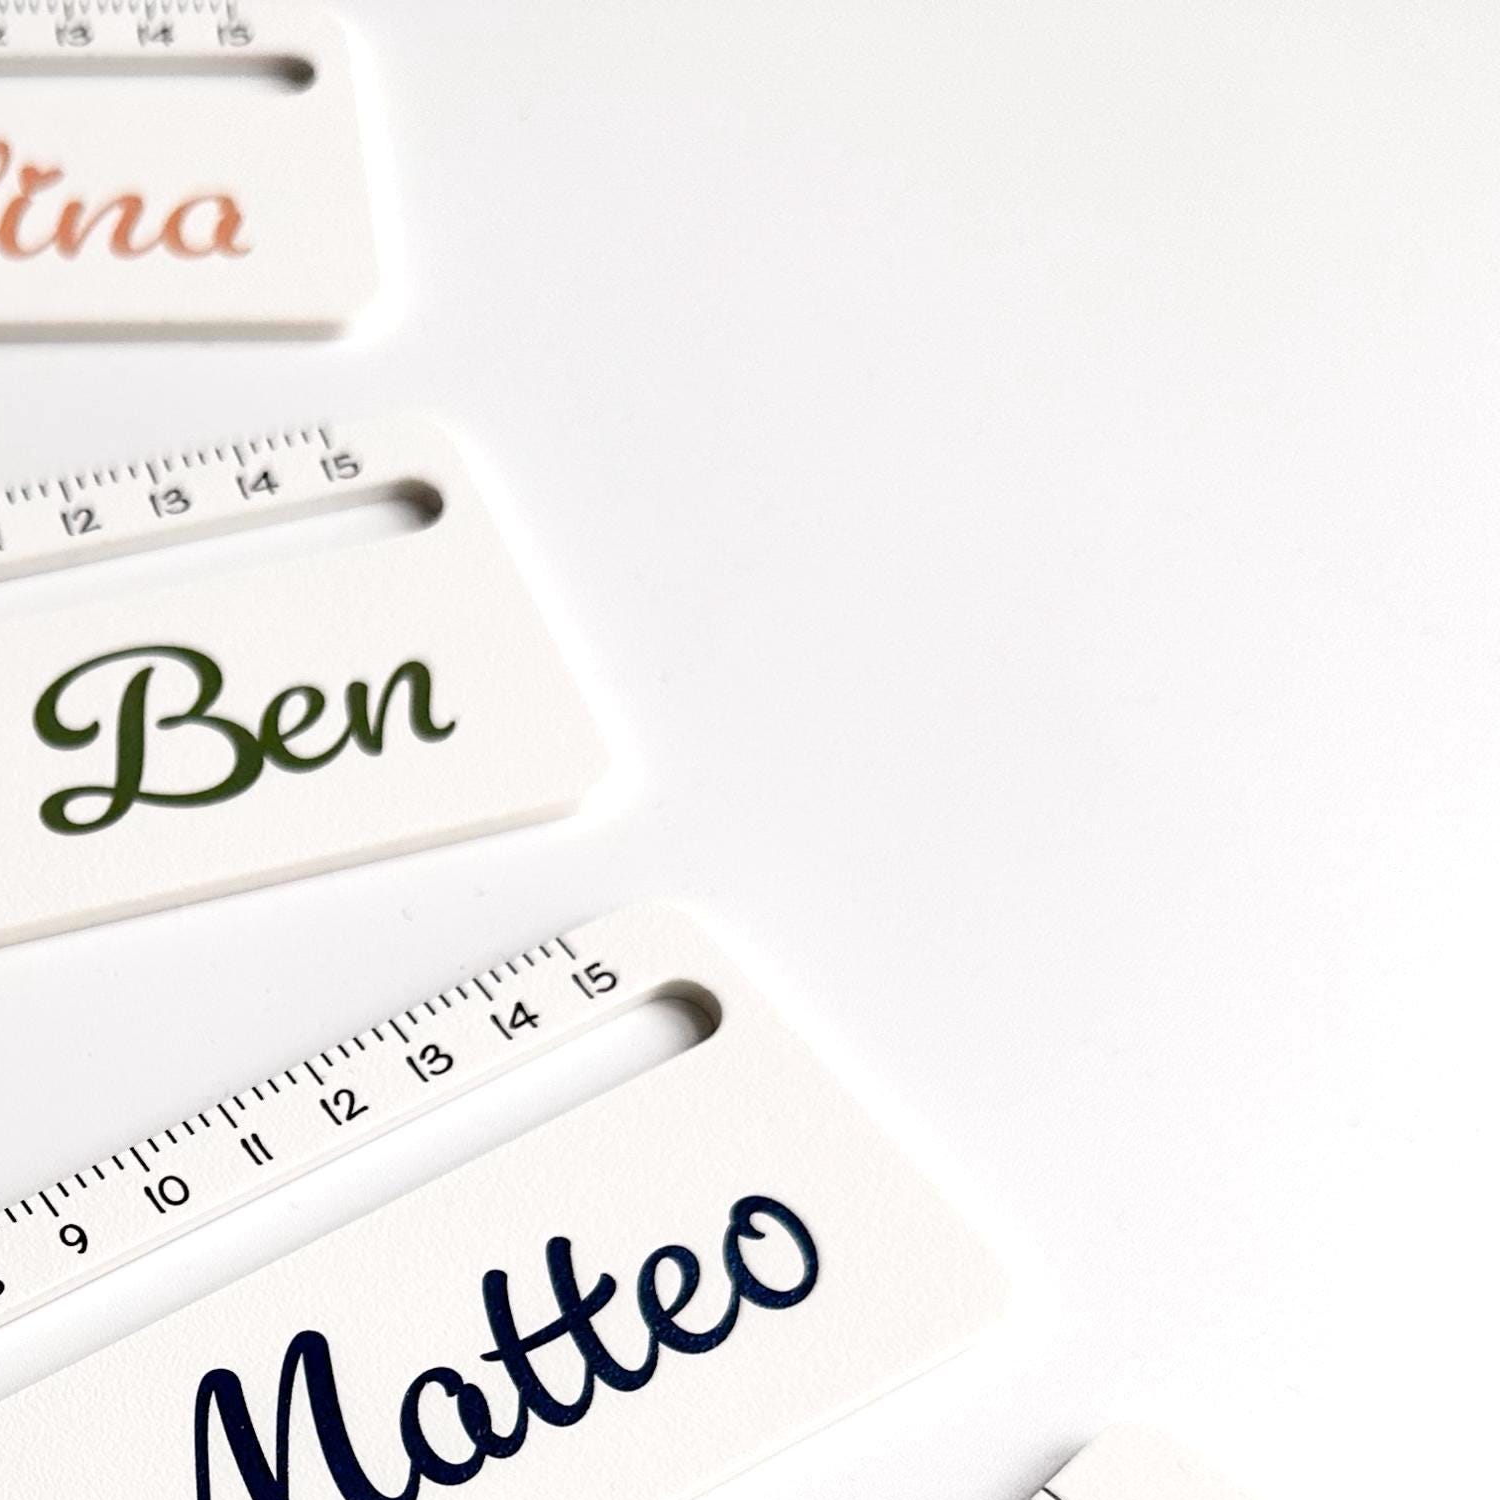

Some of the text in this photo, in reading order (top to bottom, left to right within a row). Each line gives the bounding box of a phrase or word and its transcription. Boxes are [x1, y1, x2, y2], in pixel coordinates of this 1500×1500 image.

[61, 507, 101, 536] 12
[149, 487, 191, 517] 13
[236, 470, 279, 499] 14
[320, 452, 360, 481] 15
[33, 643, 456, 835] Ben
[59, 1224, 88, 1254] 9
[144, 1175, 190, 1214] 10
[240, 1133, 273, 1165] 11
[320, 1089, 369, 1126] 12
[406, 1044, 453, 1082] 13
[490, 1001, 539, 1040] 14
[572, 962, 618, 999] 15
